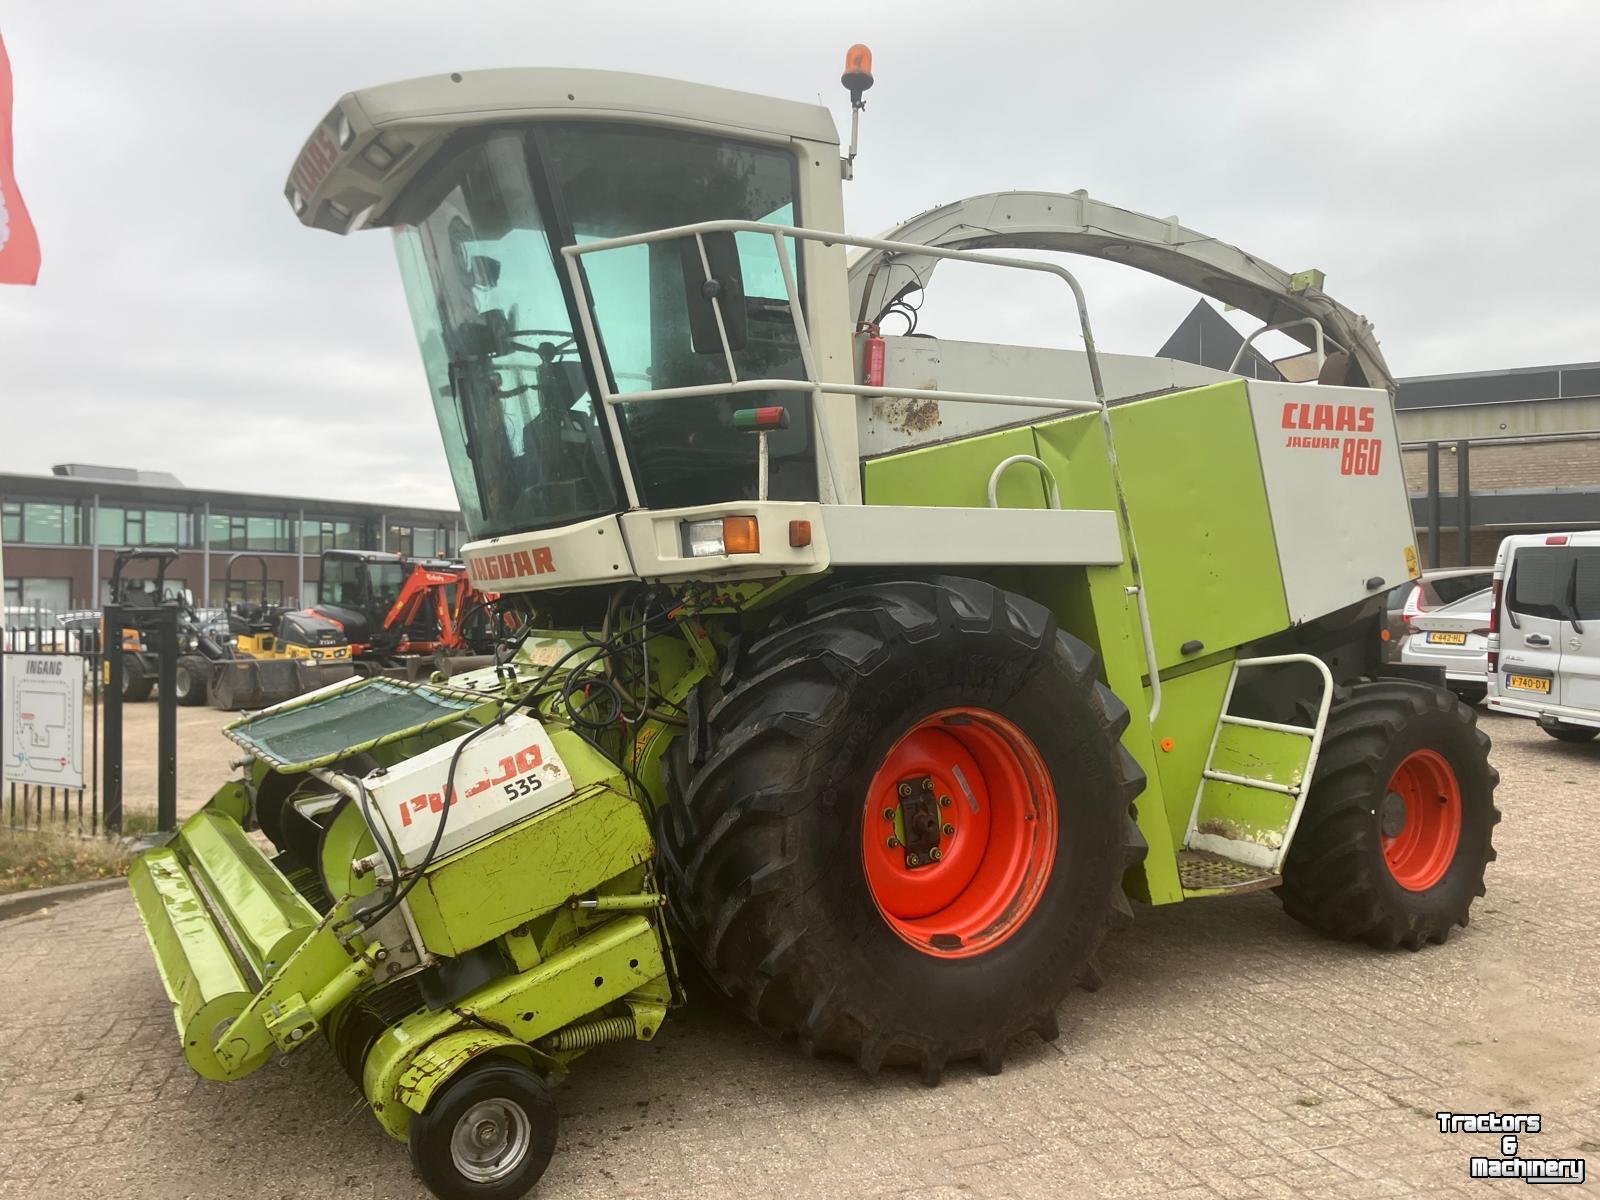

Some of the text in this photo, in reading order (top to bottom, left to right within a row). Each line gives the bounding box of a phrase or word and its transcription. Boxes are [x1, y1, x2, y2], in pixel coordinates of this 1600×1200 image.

[1281, 403, 1375, 432] CLAAS
[1285, 436, 1382, 476] JAGUAR 860
[26, 660, 62, 676] INGANG
[503, 773, 542, 801] 535
